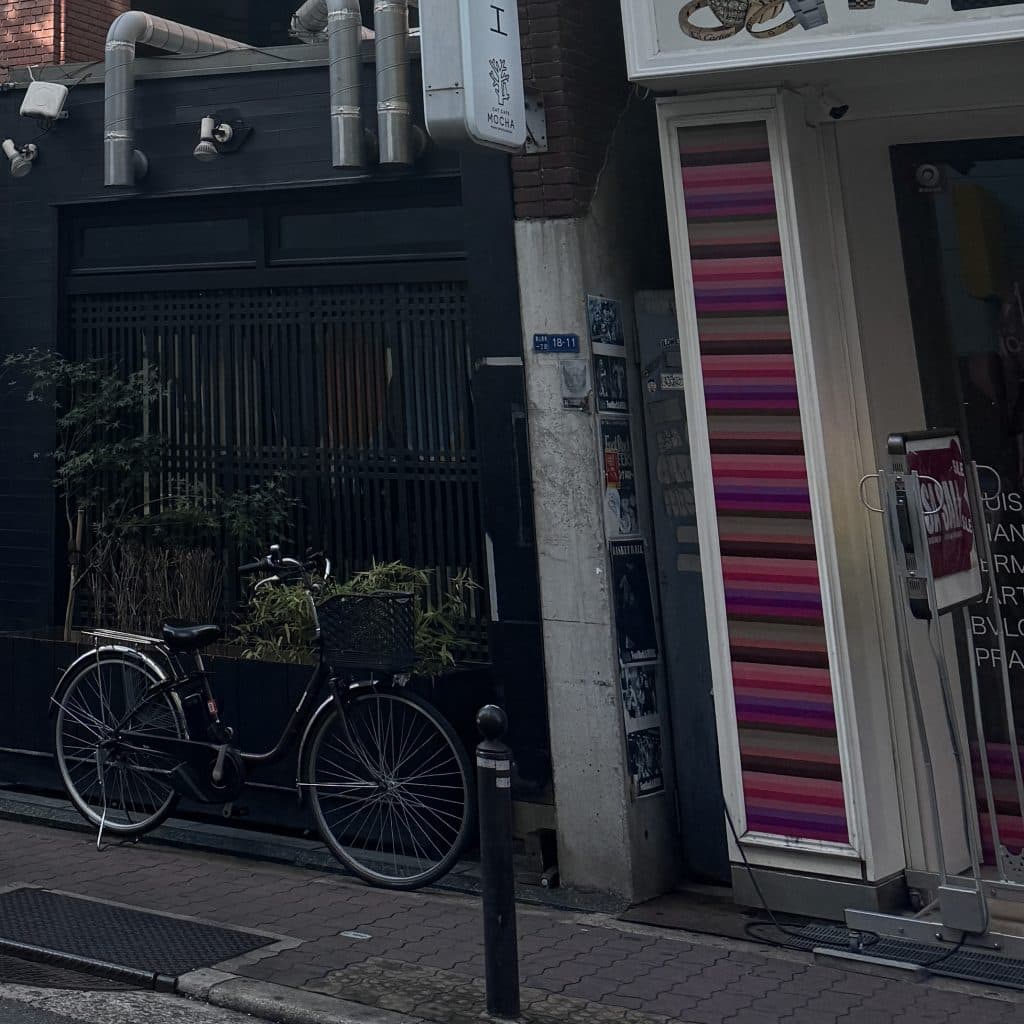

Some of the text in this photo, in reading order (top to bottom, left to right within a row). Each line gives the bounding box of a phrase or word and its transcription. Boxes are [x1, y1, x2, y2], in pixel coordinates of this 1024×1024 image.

[487, 113, 515, 129] MOCHA
[553, 337, 576, 348] 18-11
[985, 492, 1023, 512] UIS
